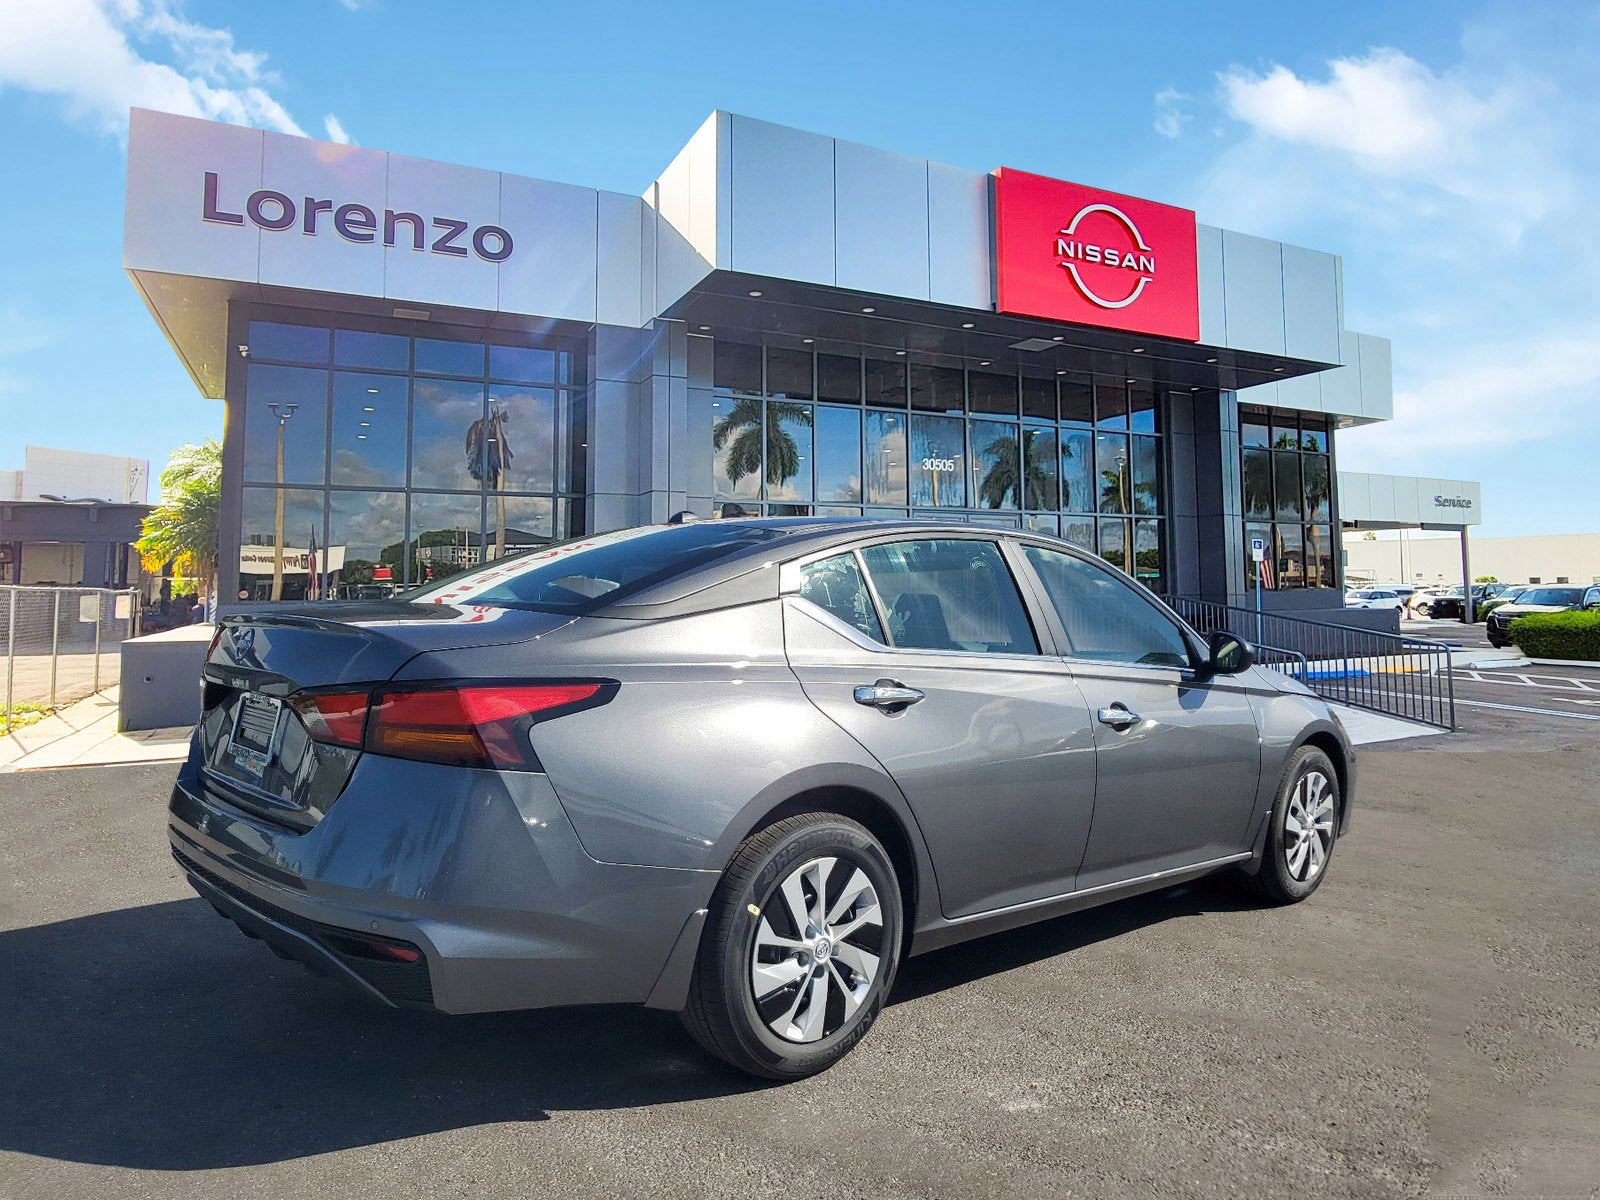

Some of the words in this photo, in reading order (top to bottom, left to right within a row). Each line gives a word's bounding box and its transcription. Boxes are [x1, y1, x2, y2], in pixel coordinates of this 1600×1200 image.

[203, 170, 515, 263] Lorenzo
[1056, 237, 1156, 274] NISSAN
[922, 457, 955, 472] 30505
[1434, 495, 1473, 509] Service
